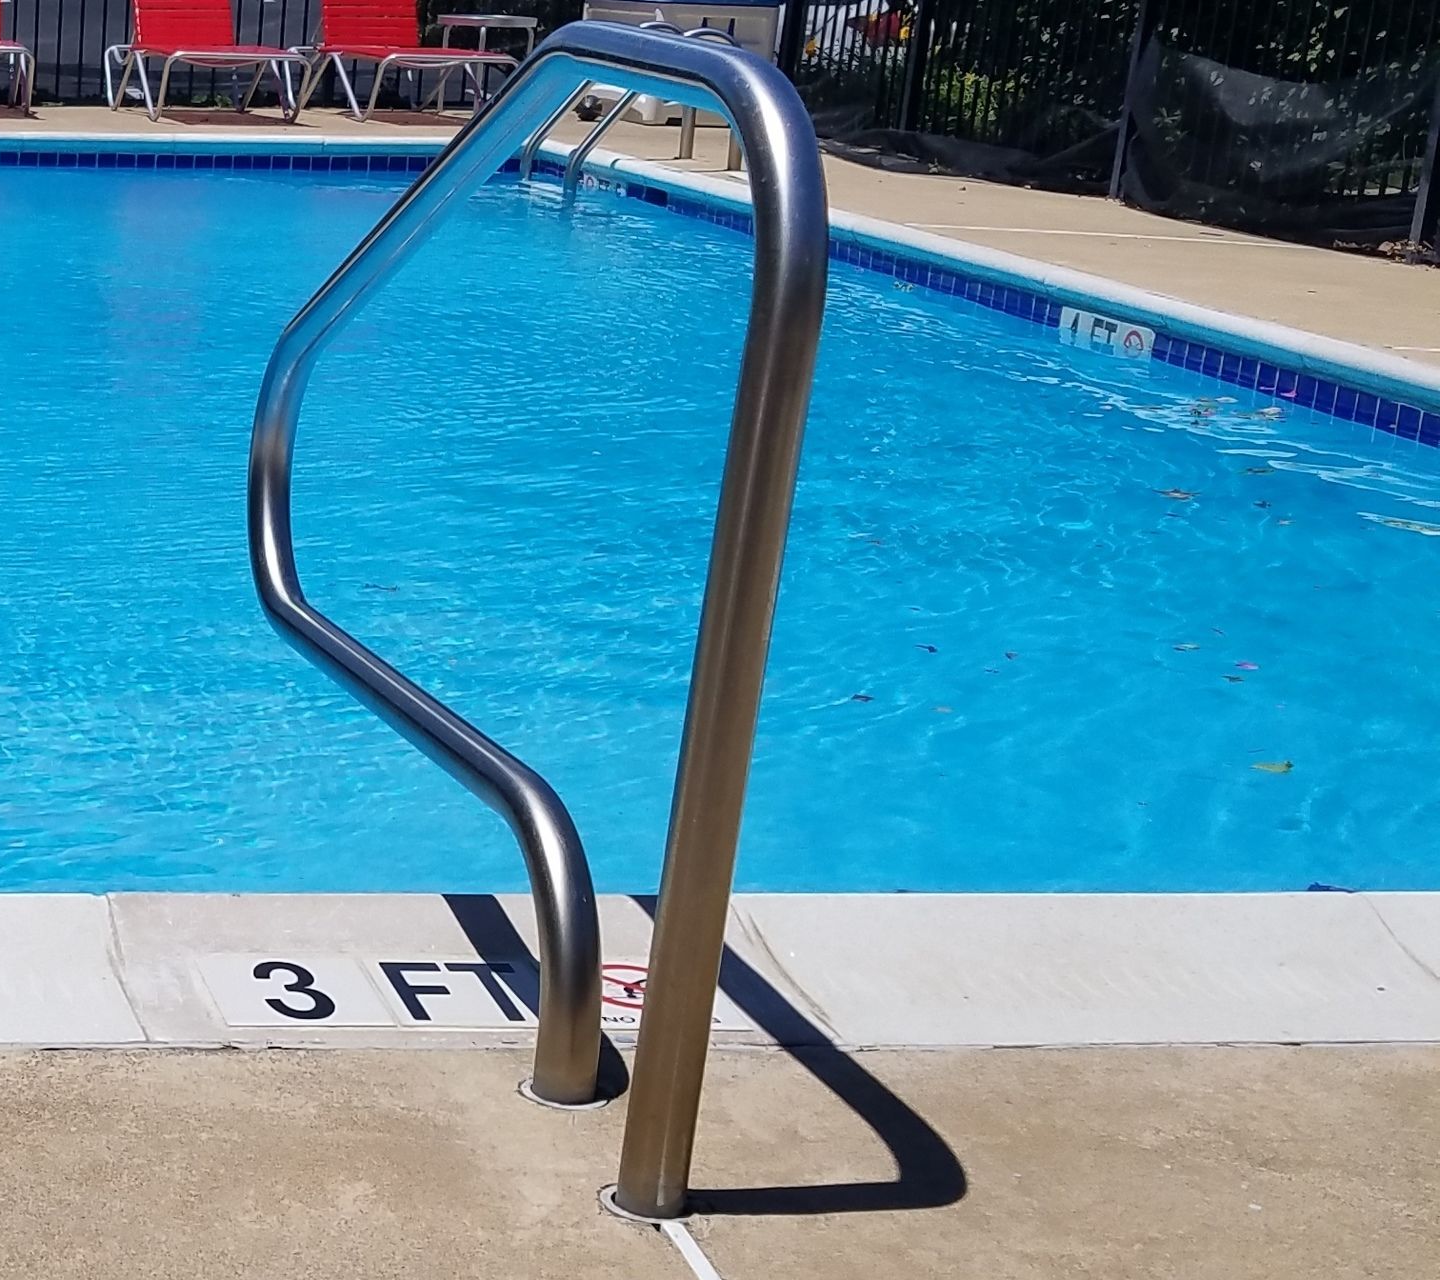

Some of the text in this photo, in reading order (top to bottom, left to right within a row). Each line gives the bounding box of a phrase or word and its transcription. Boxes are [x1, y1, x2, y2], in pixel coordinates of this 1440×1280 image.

[253, 961, 526, 1022] 3 FT
[602, 1015, 636, 1024] NO
